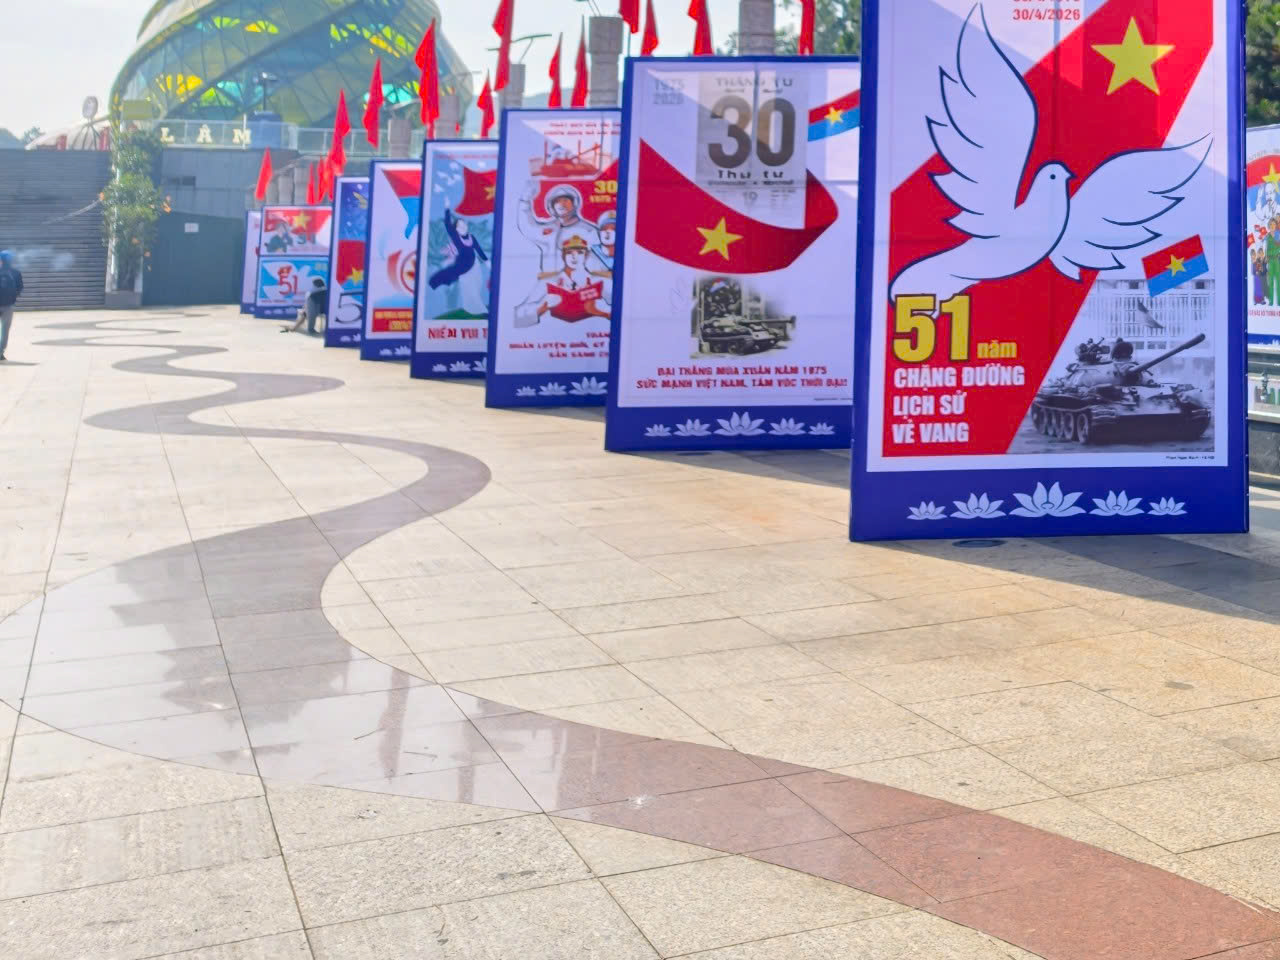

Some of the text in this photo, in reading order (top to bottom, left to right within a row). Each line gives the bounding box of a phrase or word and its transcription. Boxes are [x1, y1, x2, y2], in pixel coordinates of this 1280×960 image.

[1013, 8, 1081, 20] 30/4/2026
[708, 95, 796, 168] 30
[892, 294, 1017, 363] 51 năm
[894, 362, 1025, 391] CHẶNG ĐƯỜNG
[893, 390, 967, 419] LỊCH SỬ
[919, 422, 969, 443] VANG
